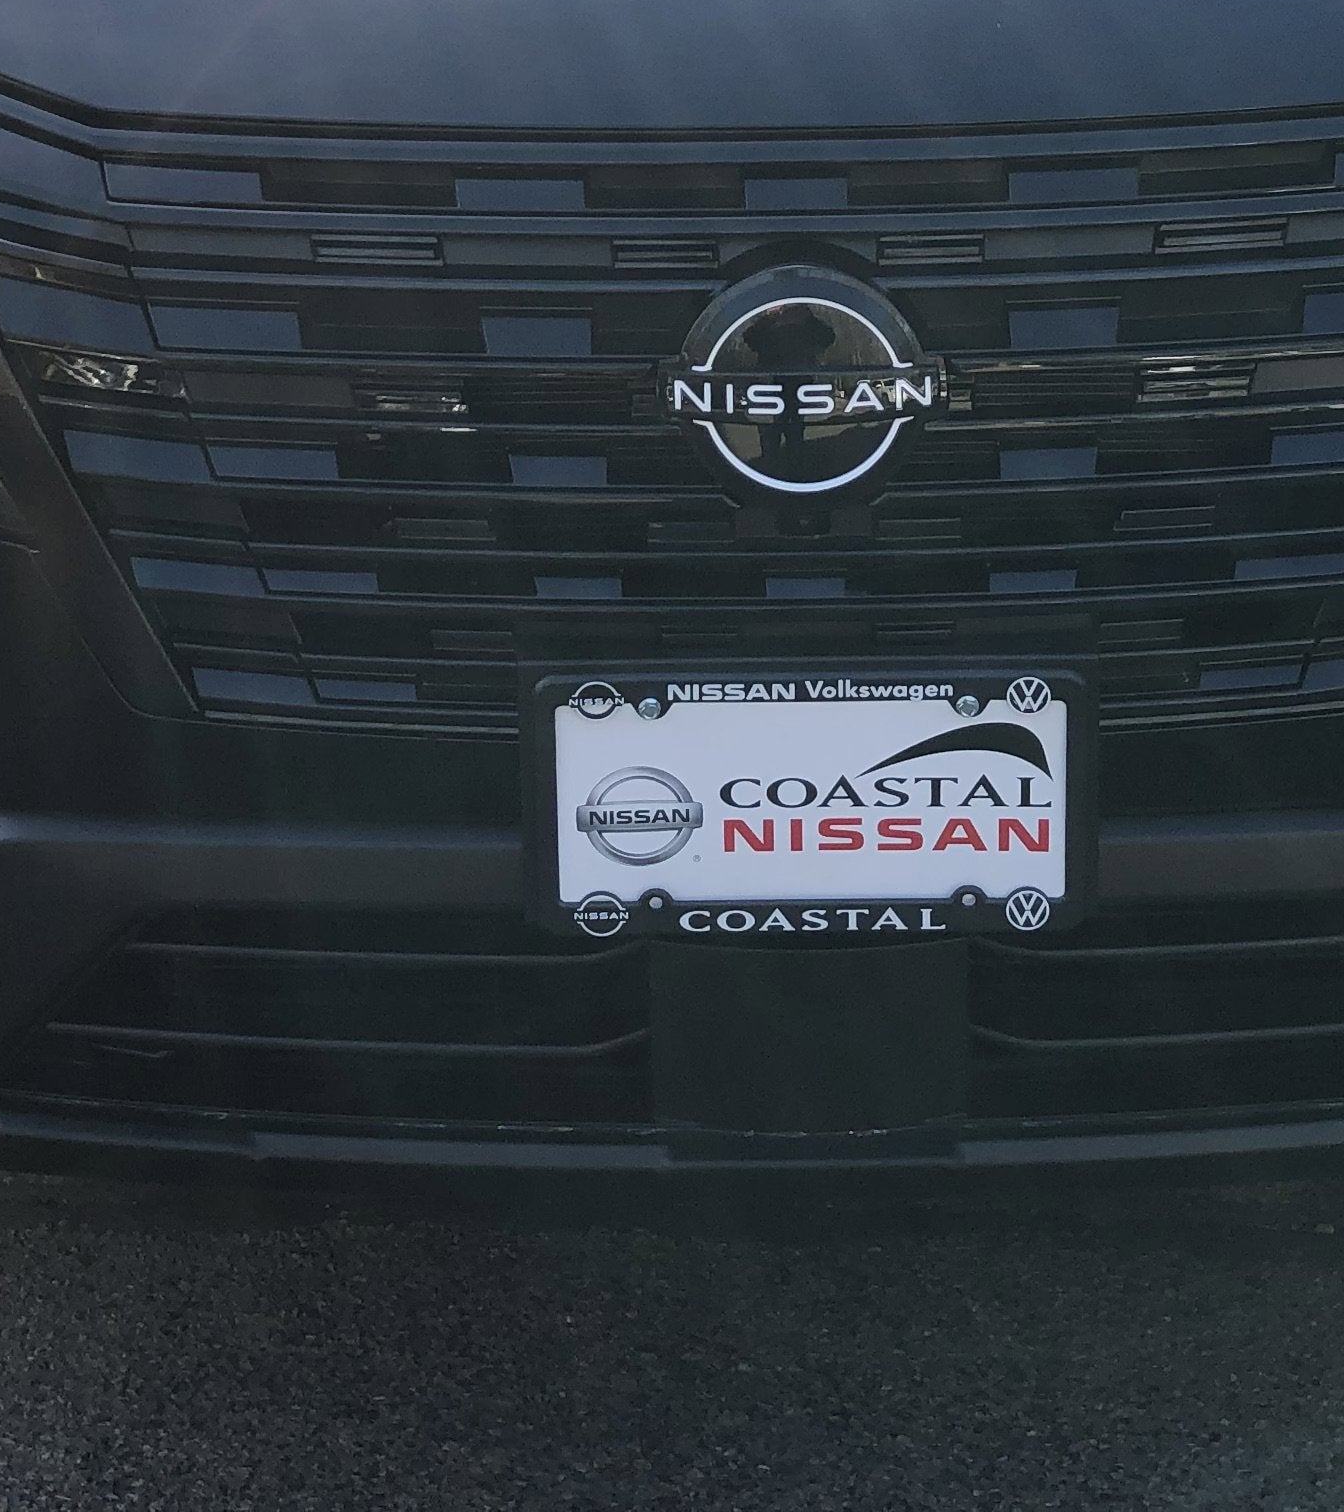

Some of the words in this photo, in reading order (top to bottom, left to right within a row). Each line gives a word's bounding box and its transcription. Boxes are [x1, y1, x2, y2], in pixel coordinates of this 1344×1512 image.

[673, 375, 933, 415] NISSAN
[568, 695, 625, 707] NISSAN
[667, 683, 795, 701] NISSAN
[804, 679, 954, 701] Volkswagen
[719, 774, 1053, 809] COASTAL
[588, 806, 691, 827] NISSAN
[722, 818, 1050, 853] NISSAN
[573, 910, 630, 921] NISSAN
[678, 906, 947, 933] COASTAL
